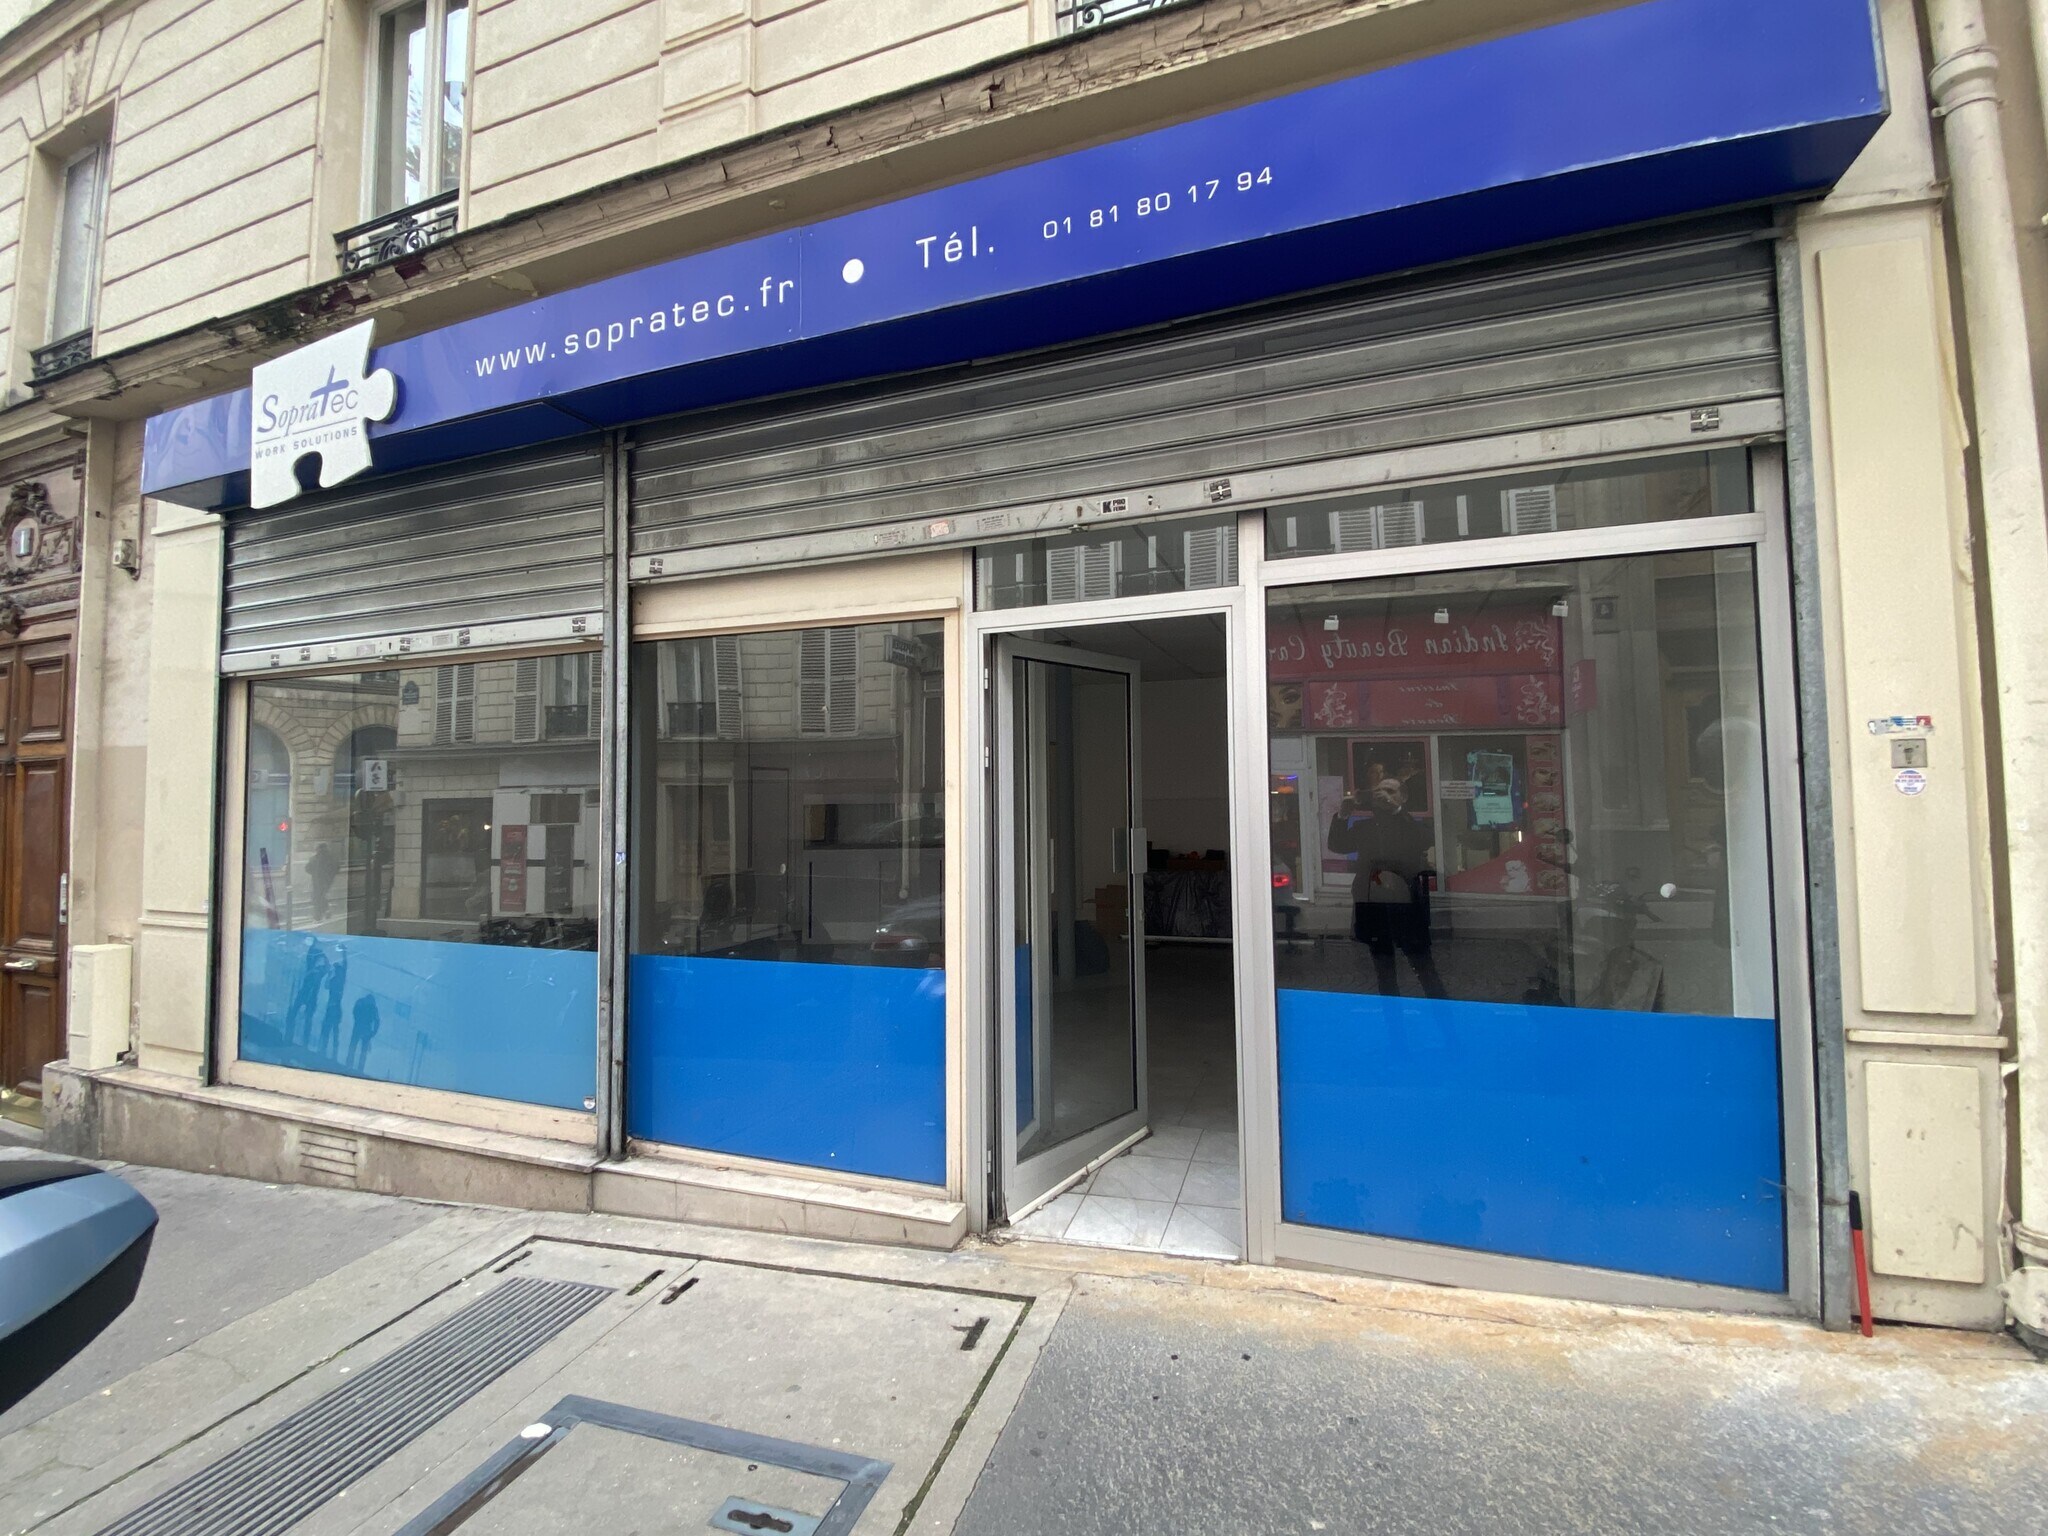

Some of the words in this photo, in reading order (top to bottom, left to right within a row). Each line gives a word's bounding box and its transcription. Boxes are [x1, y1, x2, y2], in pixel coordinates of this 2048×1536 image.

[915, 226, 995, 268] Tél.
[1043, 216, 1072, 239] 01
[1089, 205, 1119, 228] 81
[1137, 192, 1171, 216] 80
[1188, 179, 1220, 205] 17
[1237, 166, 1273, 192] 94
[475, 276, 794, 377] www.sopratec.fr
[255, 444, 286, 460] WORK
[293, 426, 358, 450] SOLUTIONS
